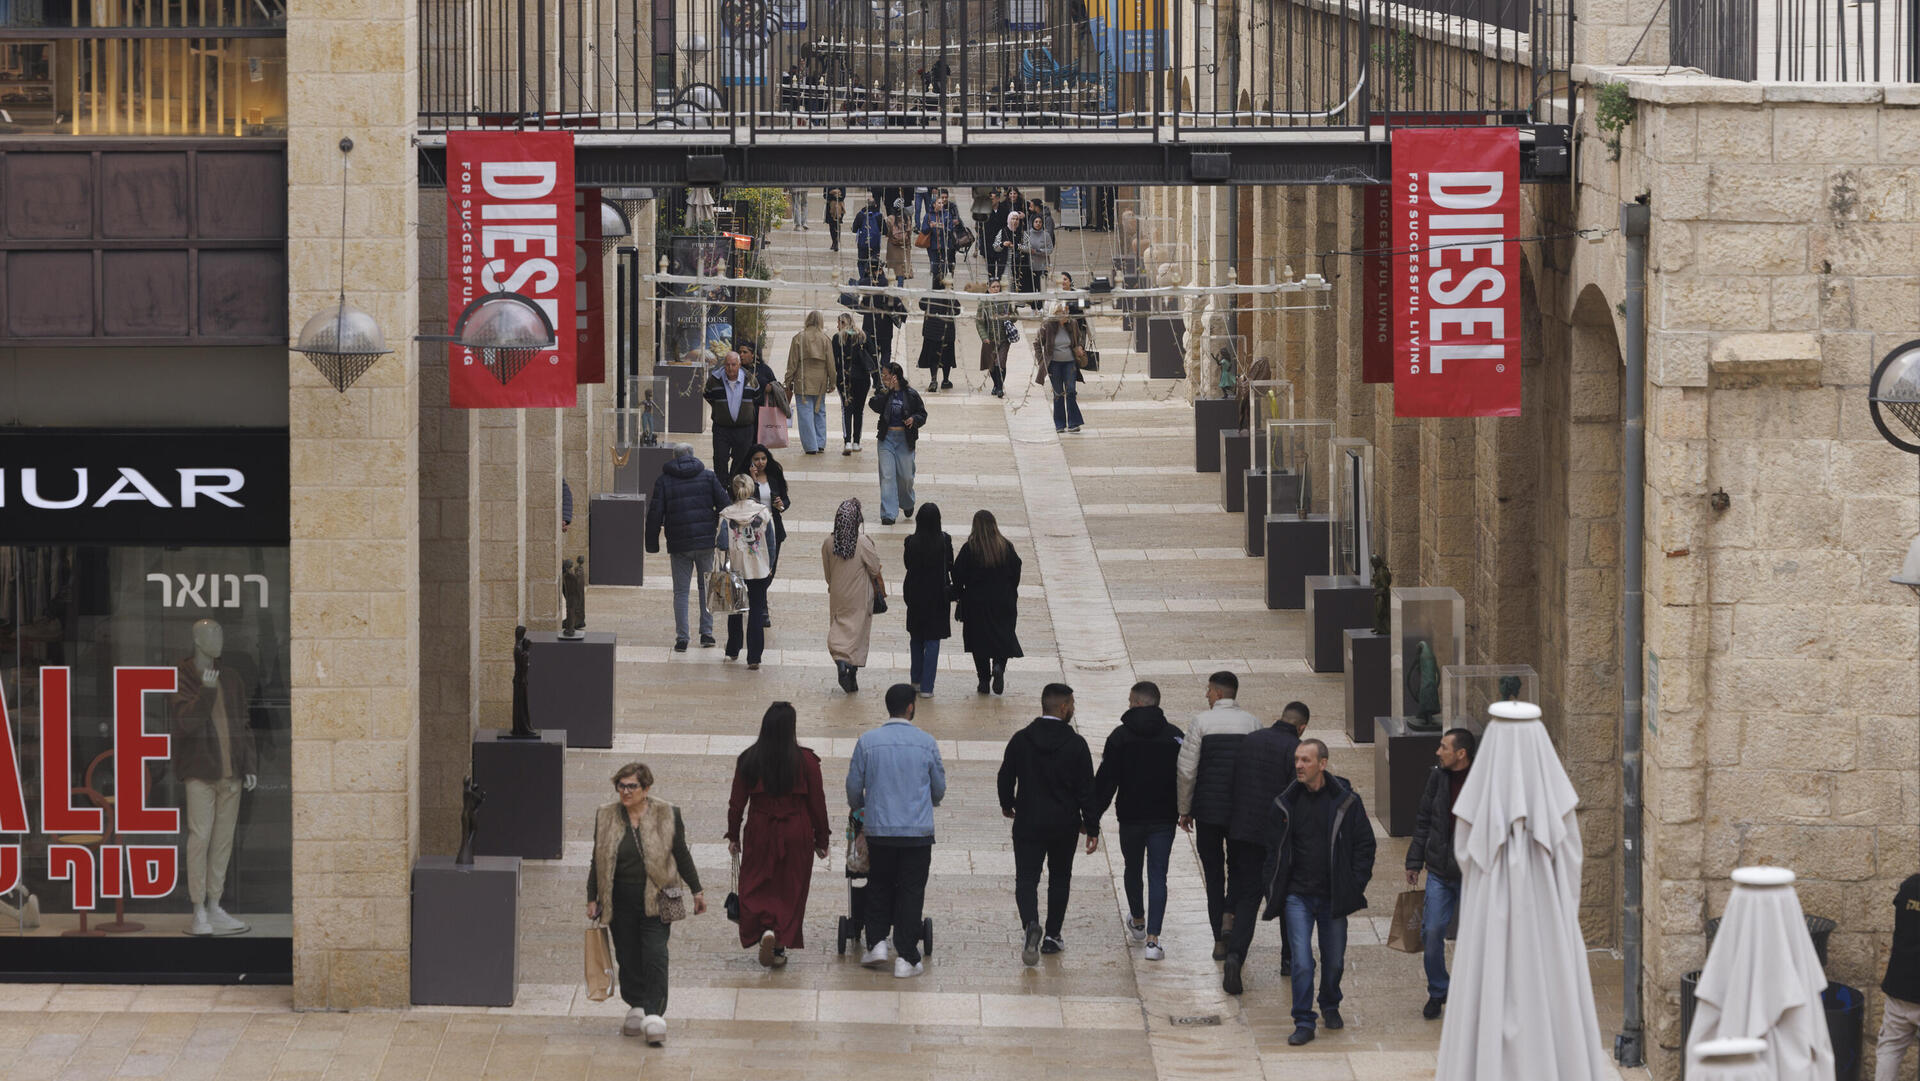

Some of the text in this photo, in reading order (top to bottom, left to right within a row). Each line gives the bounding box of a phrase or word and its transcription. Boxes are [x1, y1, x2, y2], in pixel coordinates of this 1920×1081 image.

[460, 162, 472, 194] FOR
[461, 199, 473, 306] SUCCESSFUL
[481, 161, 559, 364] DIES
[1378, 189, 1389, 343] SUCCESSFUL LIVING
[1408, 172, 1421, 375] FOR SUCCESSFUL LIVING
[1427, 171, 1506, 374] DIESEL
[0, 467, 246, 510] UAR
[146, 573, 269, 608] רנואר
[48, 844, 178, 910] סוף
